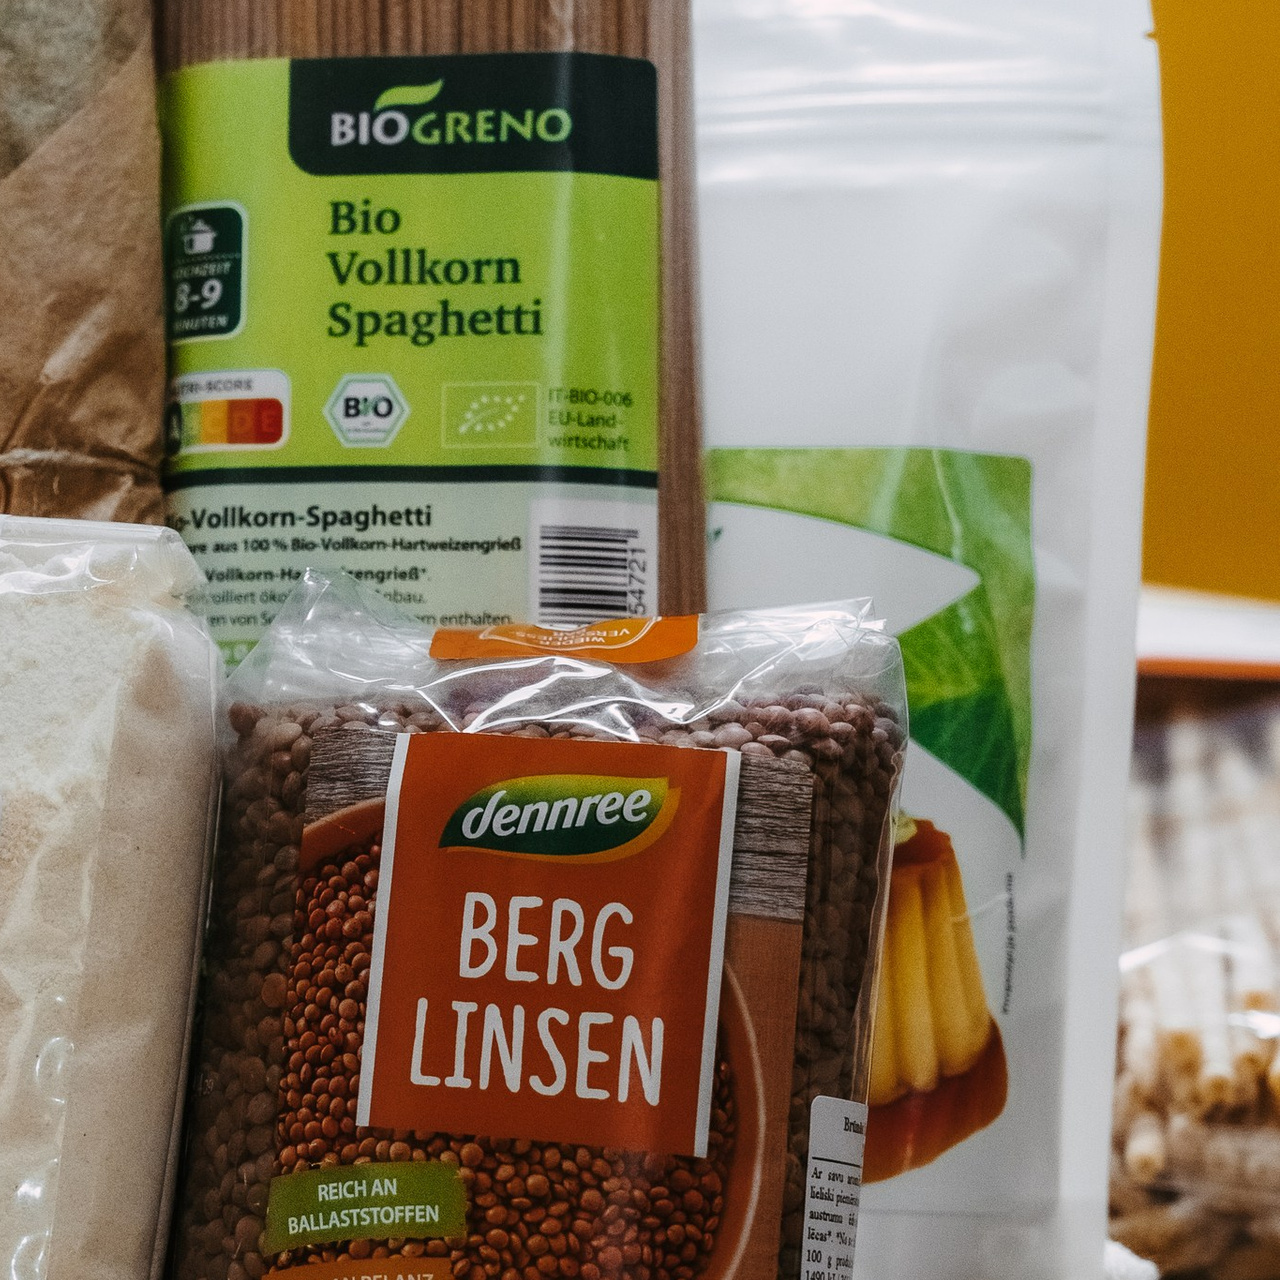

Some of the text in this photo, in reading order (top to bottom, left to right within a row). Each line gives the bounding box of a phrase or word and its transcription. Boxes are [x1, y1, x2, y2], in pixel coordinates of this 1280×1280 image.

[330, 107, 573, 147] BIOGRENO
[327, 198, 402, 236] Bio
[326, 247, 522, 286] Vollkorn
[327, 298, 544, 348] Spaghetti
[344, 396, 394, 419] BIO
[548, 434, 630, 452] wirtschaft
[243, 538, 270, 552] 100
[272, 538, 288, 552] %
[460, 788, 652, 839] dennree
[459, 891, 634, 990] BERG
[410, 997, 665, 1107] LINSEN
[318, 1178, 398, 1202] REICH AN
[811, 1167, 823, 1179] Ar
[288, 1204, 440, 1235] BALLASTSTOFFEN
[806, 1249, 822, 1264] 100
